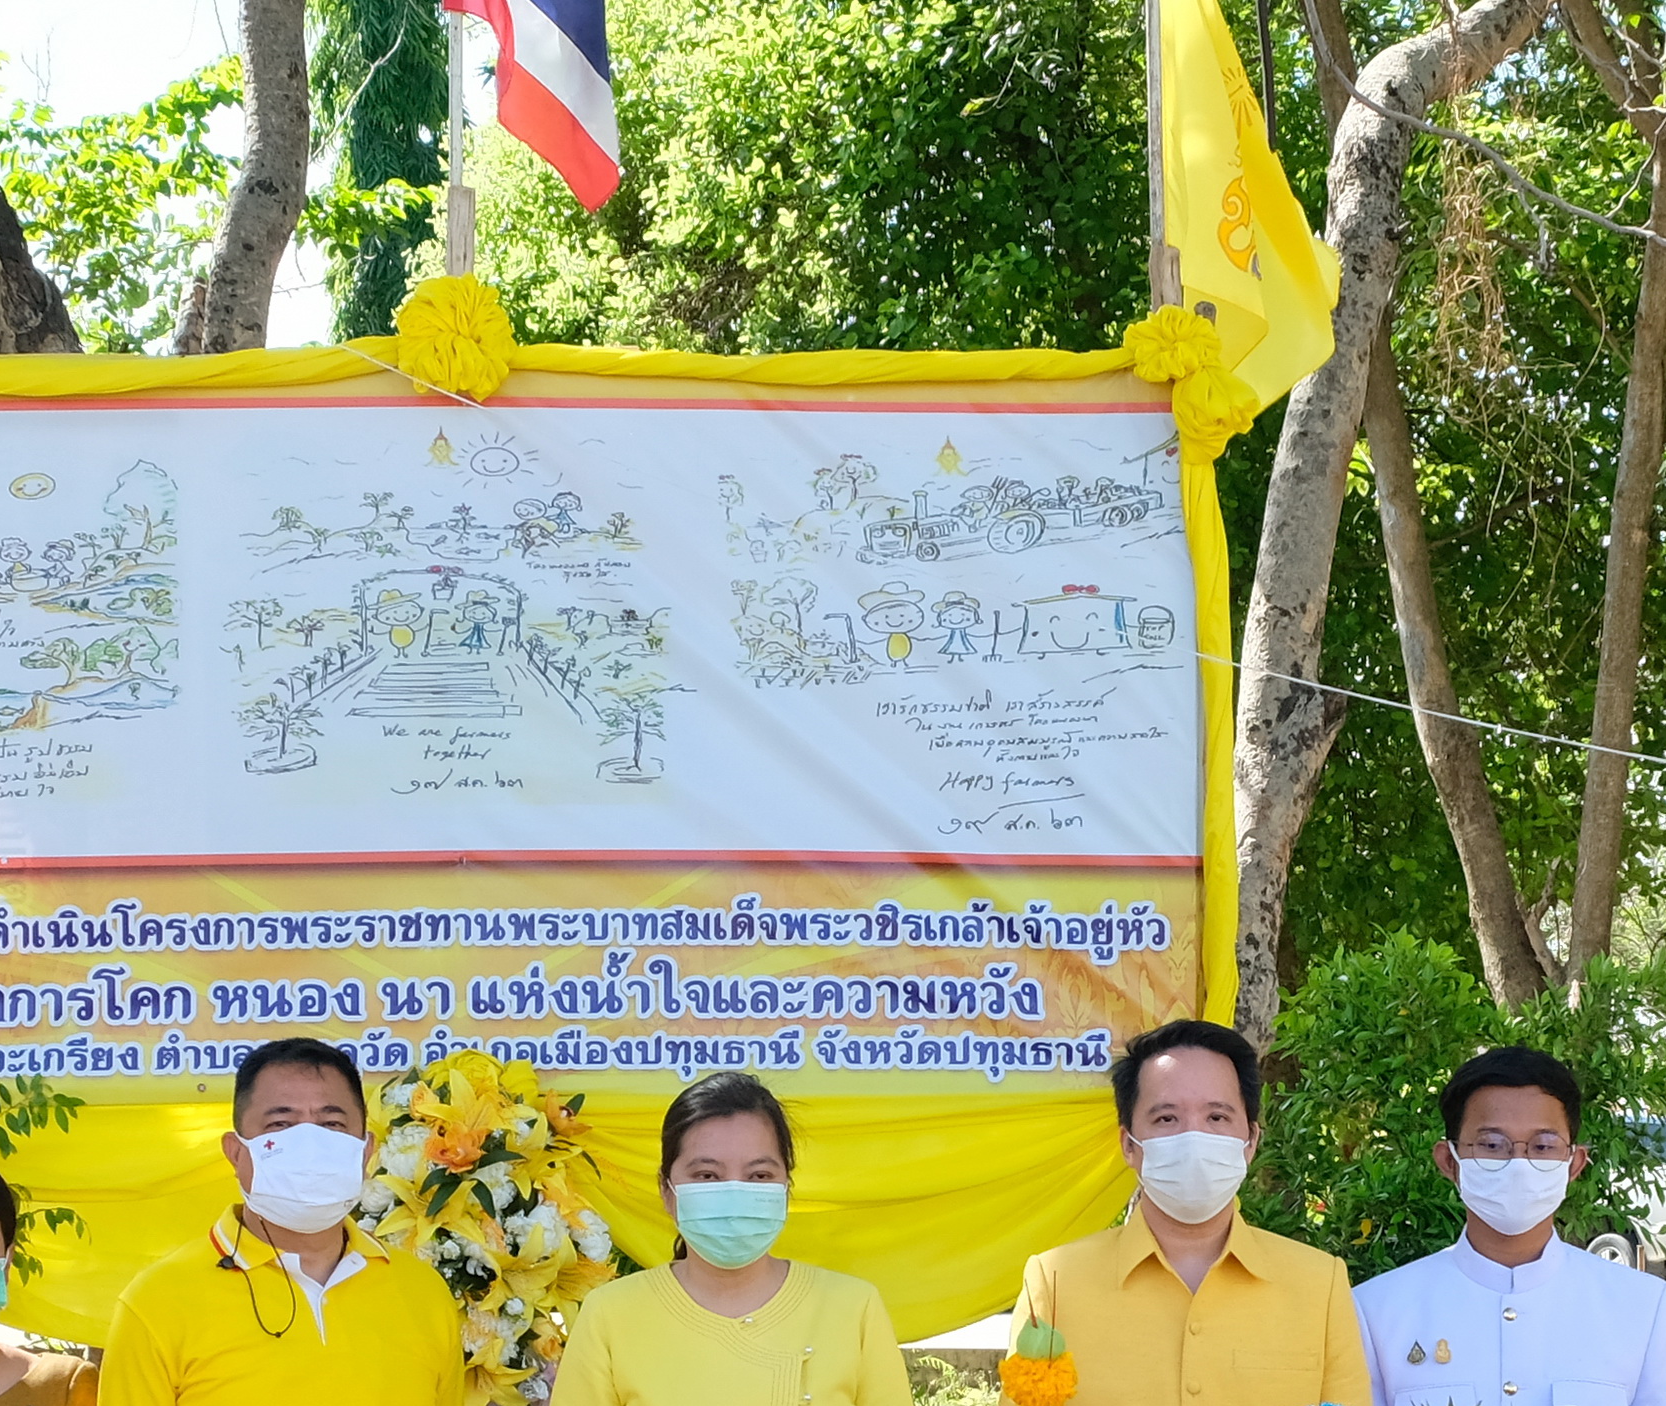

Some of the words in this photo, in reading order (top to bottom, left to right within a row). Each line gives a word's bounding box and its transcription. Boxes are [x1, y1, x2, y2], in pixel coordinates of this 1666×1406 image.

[382, 723, 410, 737] We
[417, 728, 444, 737] are
[449, 726, 512, 746] farmers
[423, 743, 493, 763] together
[938, 771, 995, 792] Happy
[1000, 771, 1076, 795] farmers
[213, 984, 361, 1018] หนอง
[381, 982, 450, 1016] นา
[473, 951, 1039, 1015] แห่งน้ำใจและความหวัง
[816, 1029, 1107, 1077] จังหวัดปทุมธานี
